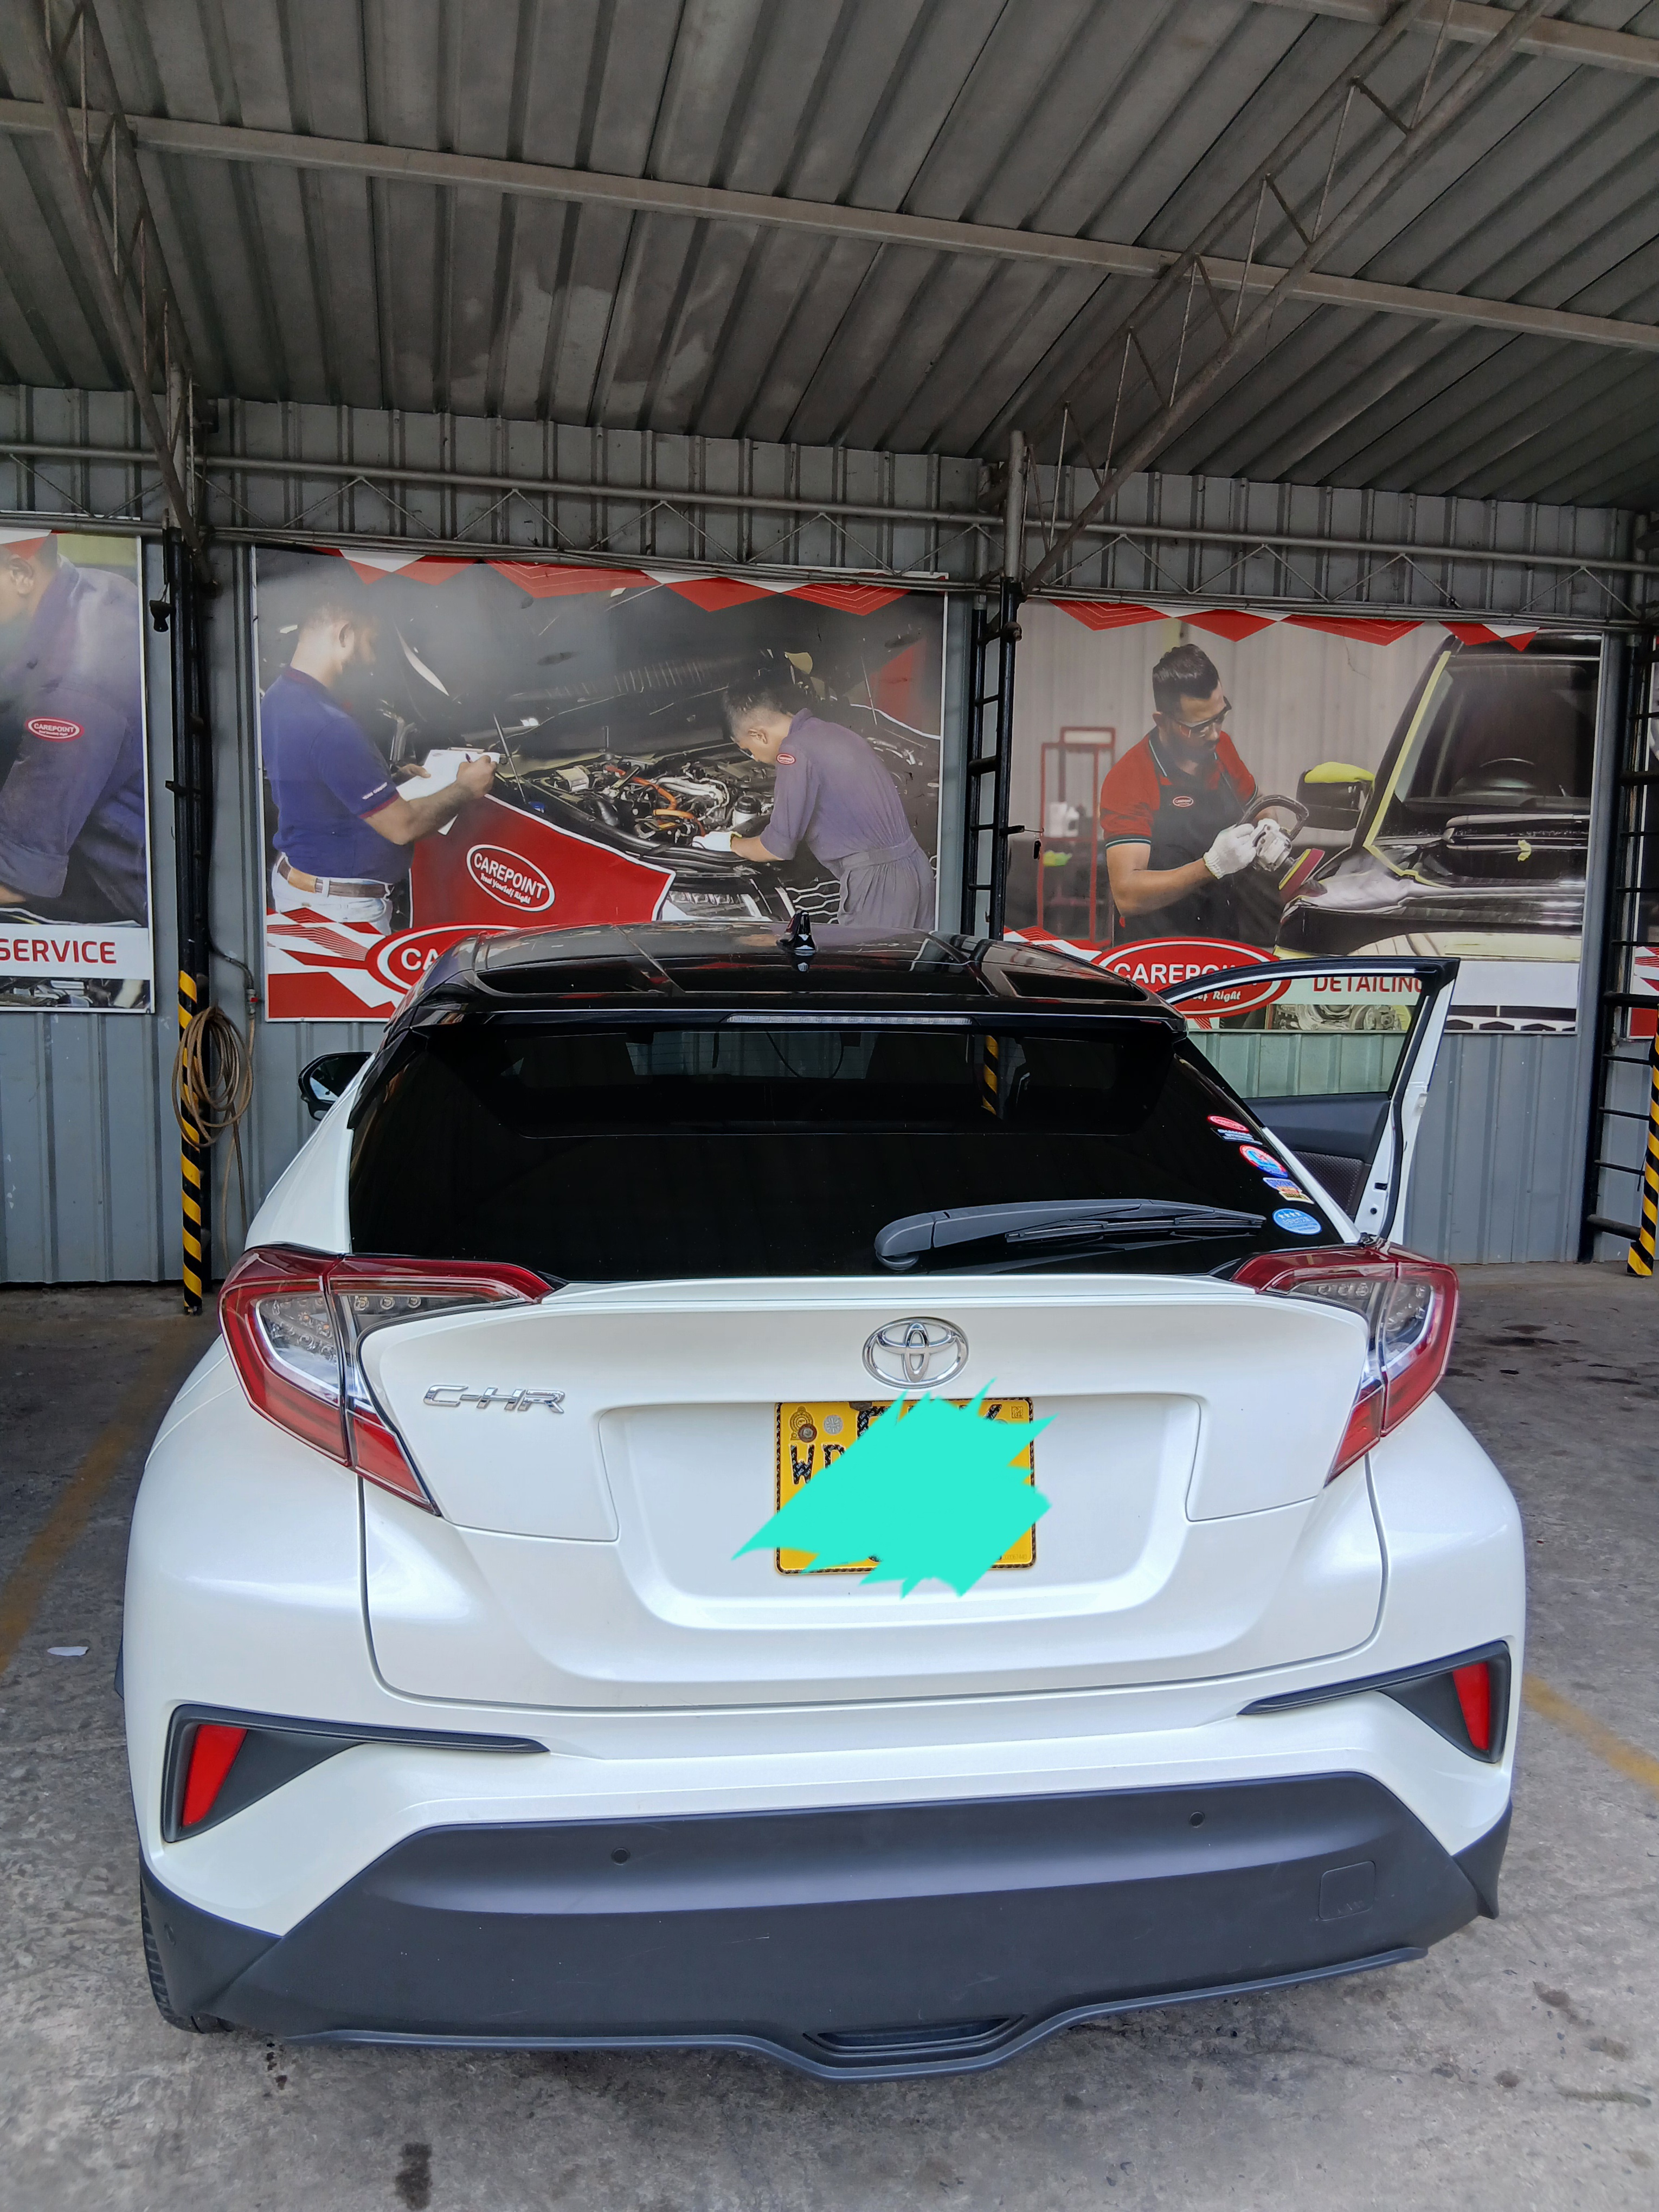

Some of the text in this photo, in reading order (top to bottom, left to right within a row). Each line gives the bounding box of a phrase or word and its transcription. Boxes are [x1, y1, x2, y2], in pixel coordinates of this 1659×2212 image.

[34, 723, 74, 733] CAREPOINT
[474, 853, 546, 898] CAREPOINT
[0, 938, 117, 963] SERVICE
[1114, 963, 1257, 986] CAREP
[1212, 991, 1241, 1002] Right
[423, 1385, 565, 1413] C-HR
